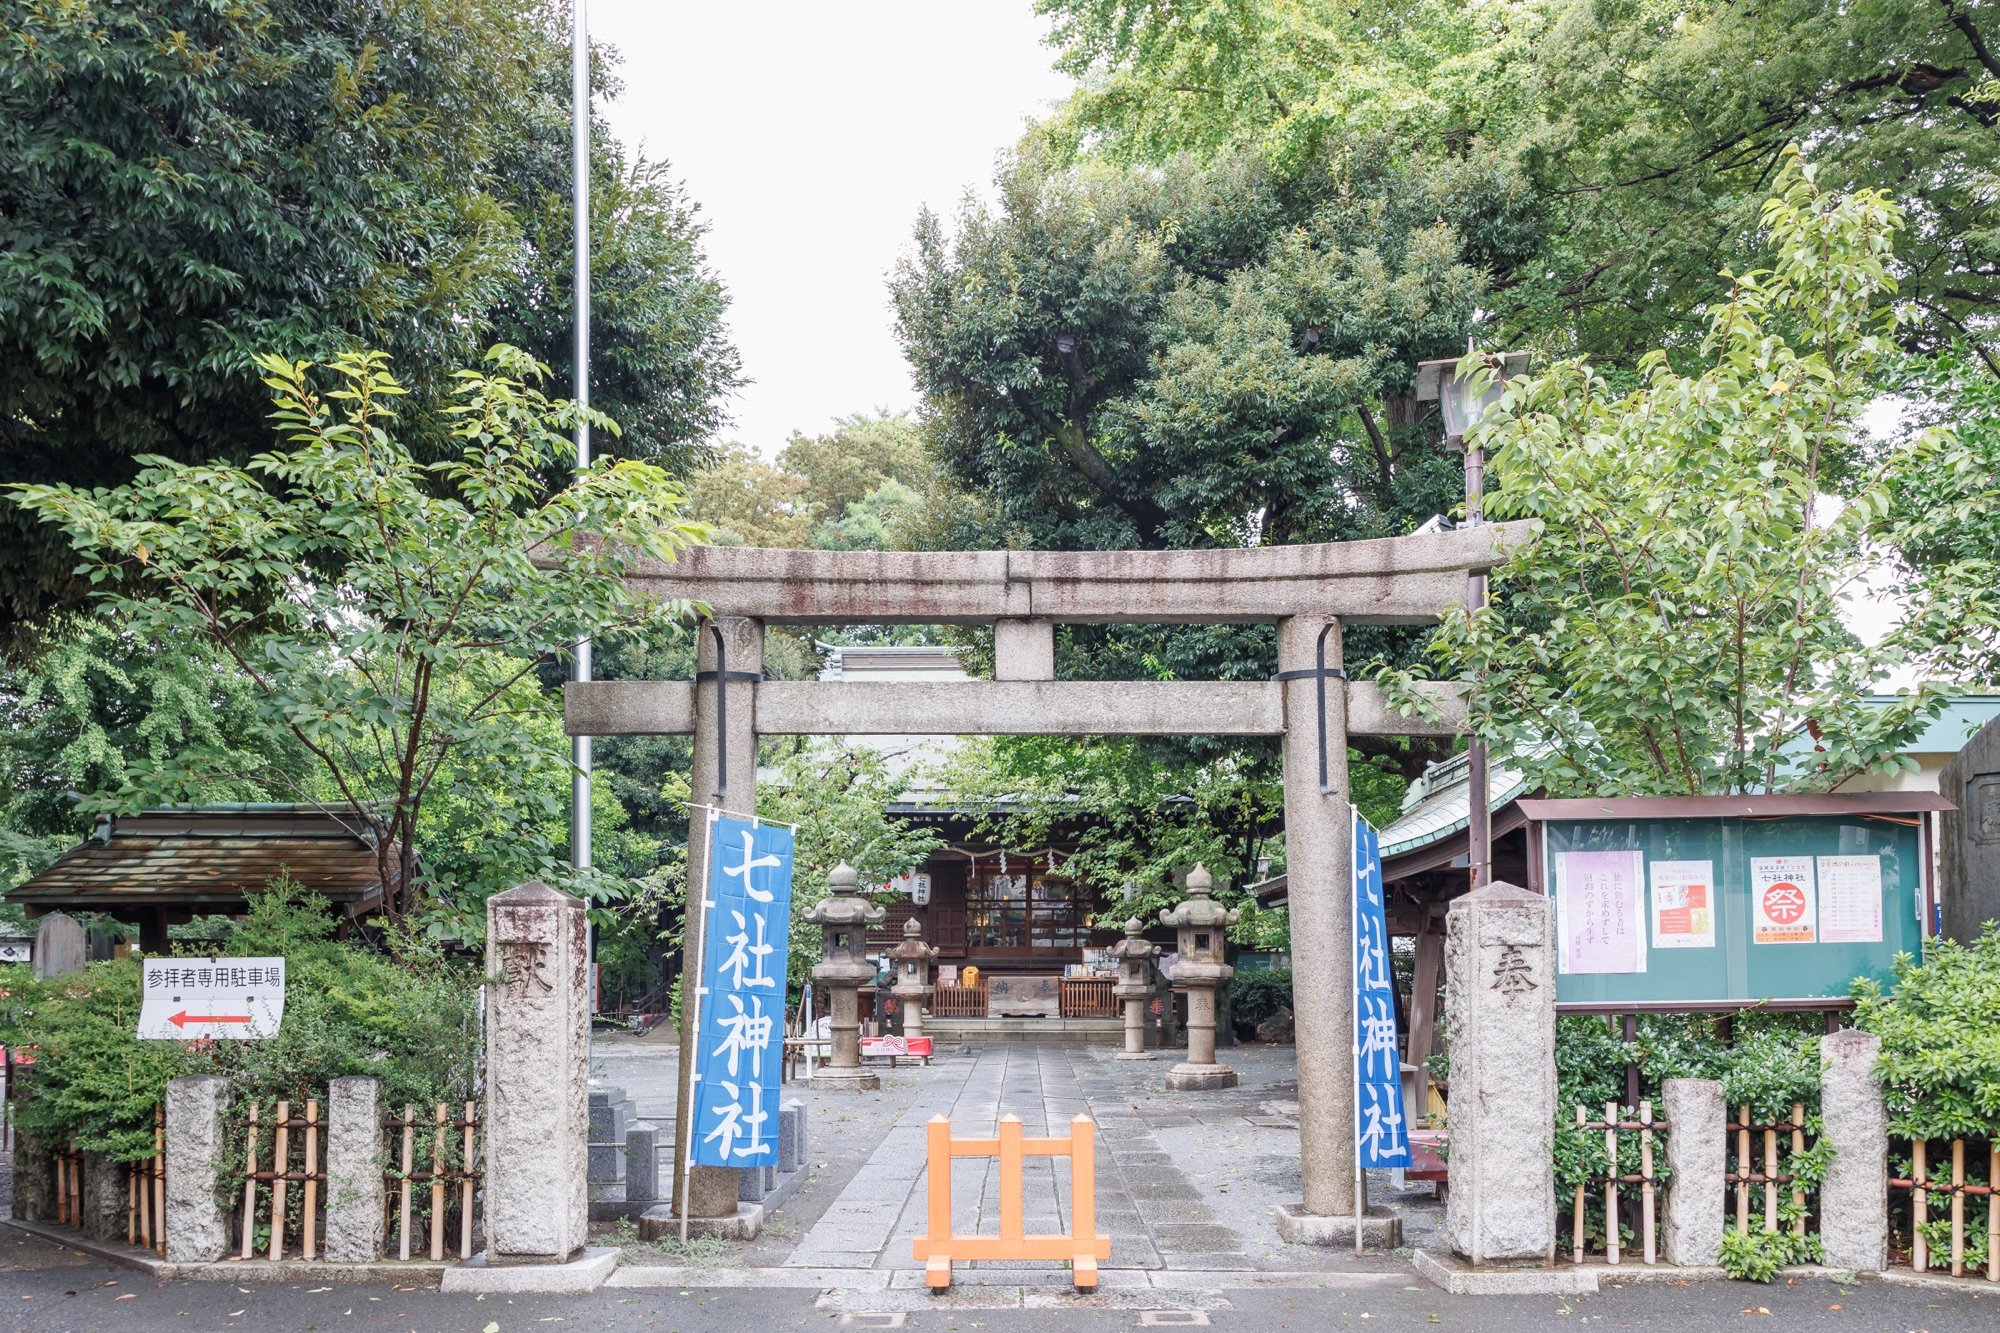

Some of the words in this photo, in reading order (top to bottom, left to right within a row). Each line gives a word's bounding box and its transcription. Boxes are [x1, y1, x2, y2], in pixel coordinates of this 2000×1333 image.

[917, 875, 927, 902] 七社神社
[1760, 873, 1807, 882] 七社神社
[1763, 888, 1805, 920] 祭
[147, 966, 281, 989] 参拝者専用駐車場
[1489, 945, 1539, 1009] 奉
[703, 829, 782, 1161] 七社神社
[1357, 833, 1408, 1162] 七社神社
